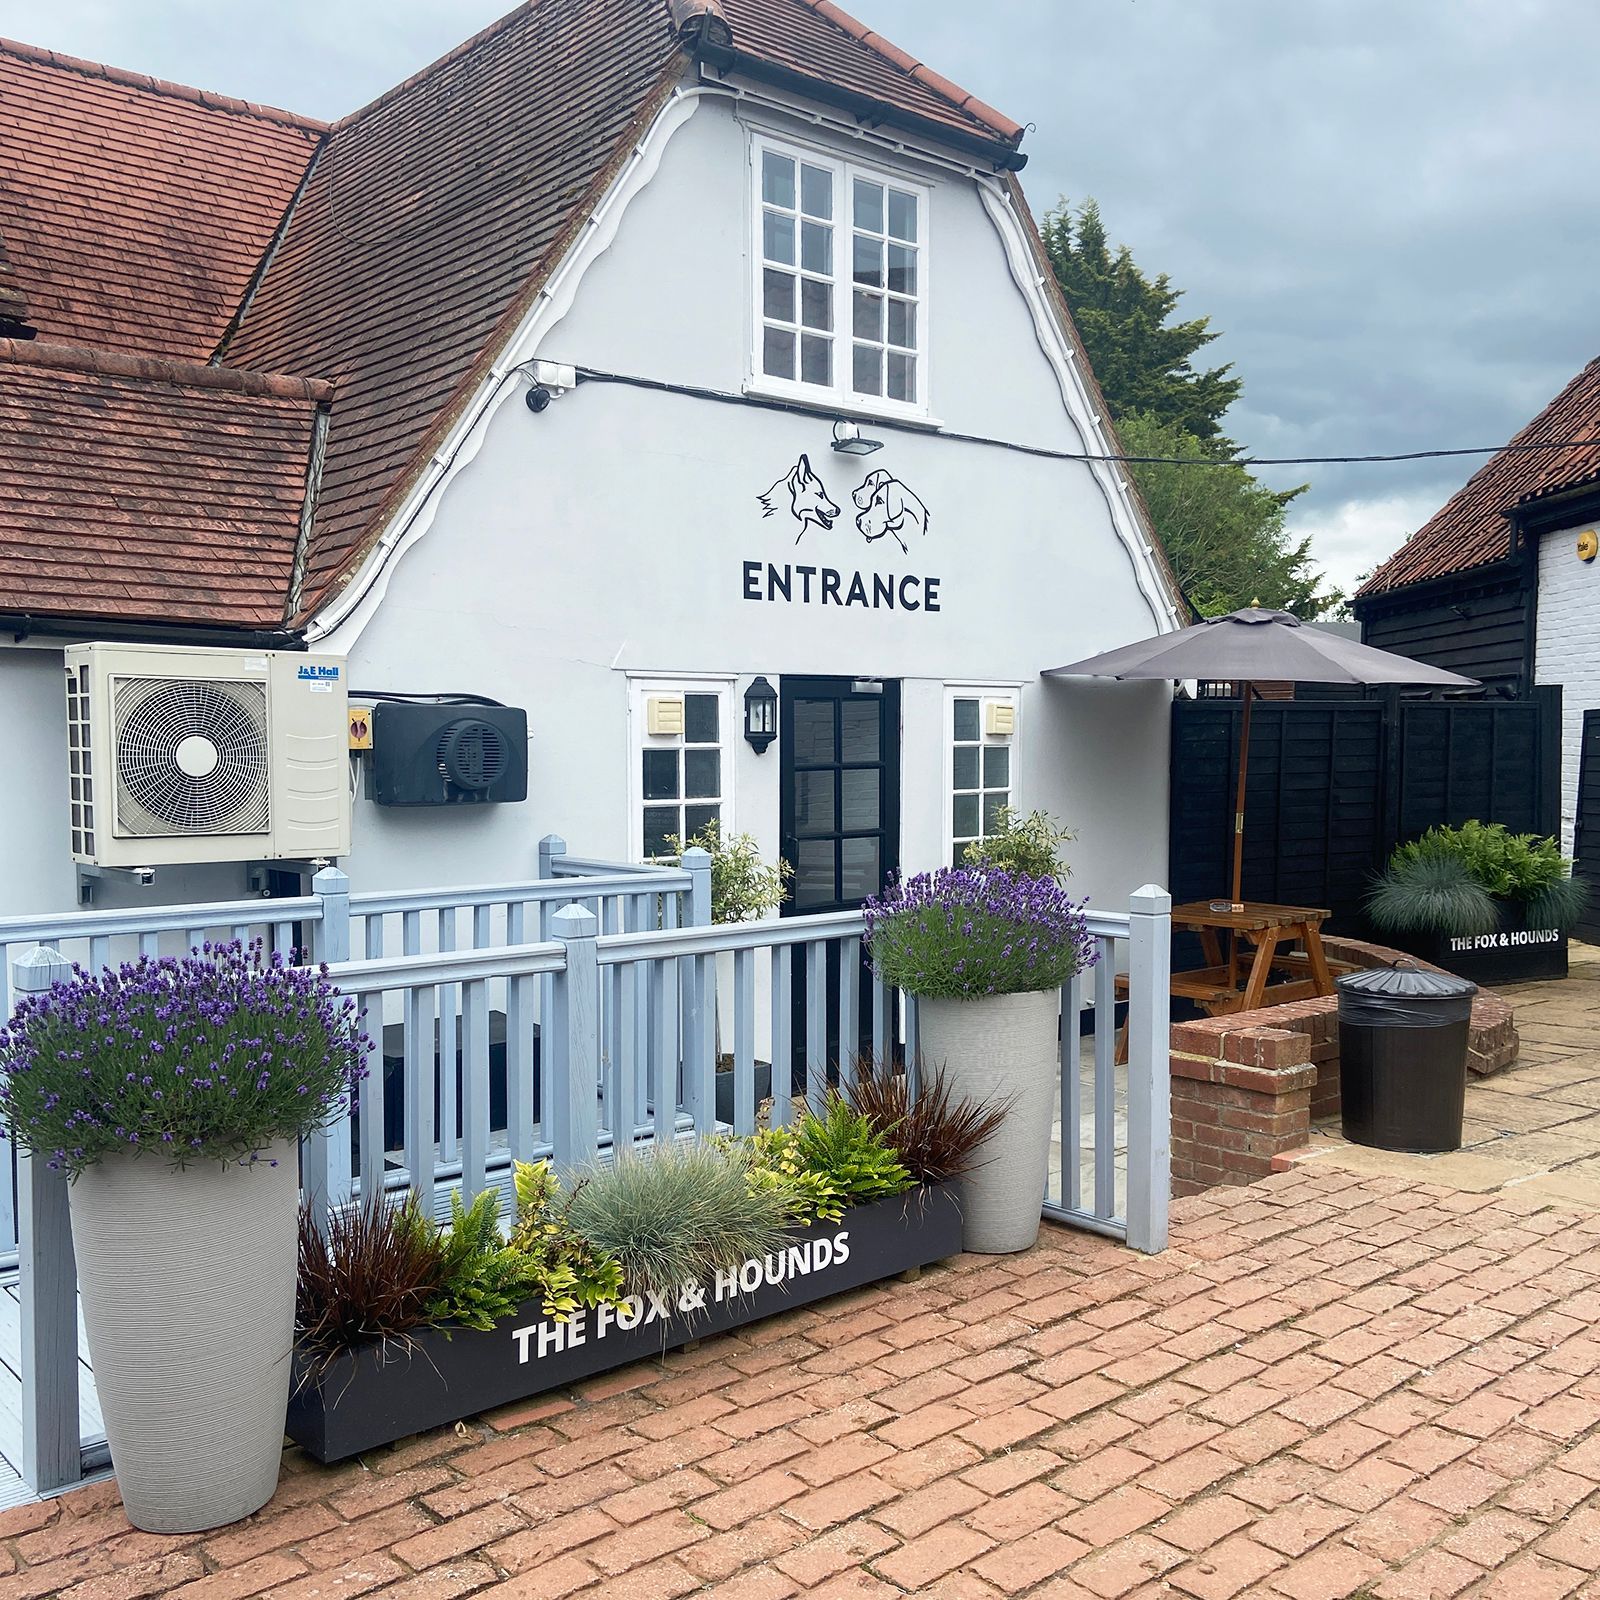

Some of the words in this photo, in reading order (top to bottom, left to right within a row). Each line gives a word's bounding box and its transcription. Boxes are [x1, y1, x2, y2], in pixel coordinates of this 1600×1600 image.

[743, 561, 940, 612] ENTRANCE
[298, 665, 316, 676] J&E
[318, 666, 339, 676] Hall
[1451, 936, 1472, 951] THE
[1474, 934, 1498, 949] FOX
[1500, 933, 1509, 947] &
[1511, 929, 1559, 946] HOUNDS
[512, 1309, 586, 1364] THE
[597, 1288, 671, 1339] FOX
[679, 1276, 707, 1312] &
[715, 1231, 850, 1303] HOUNDS
